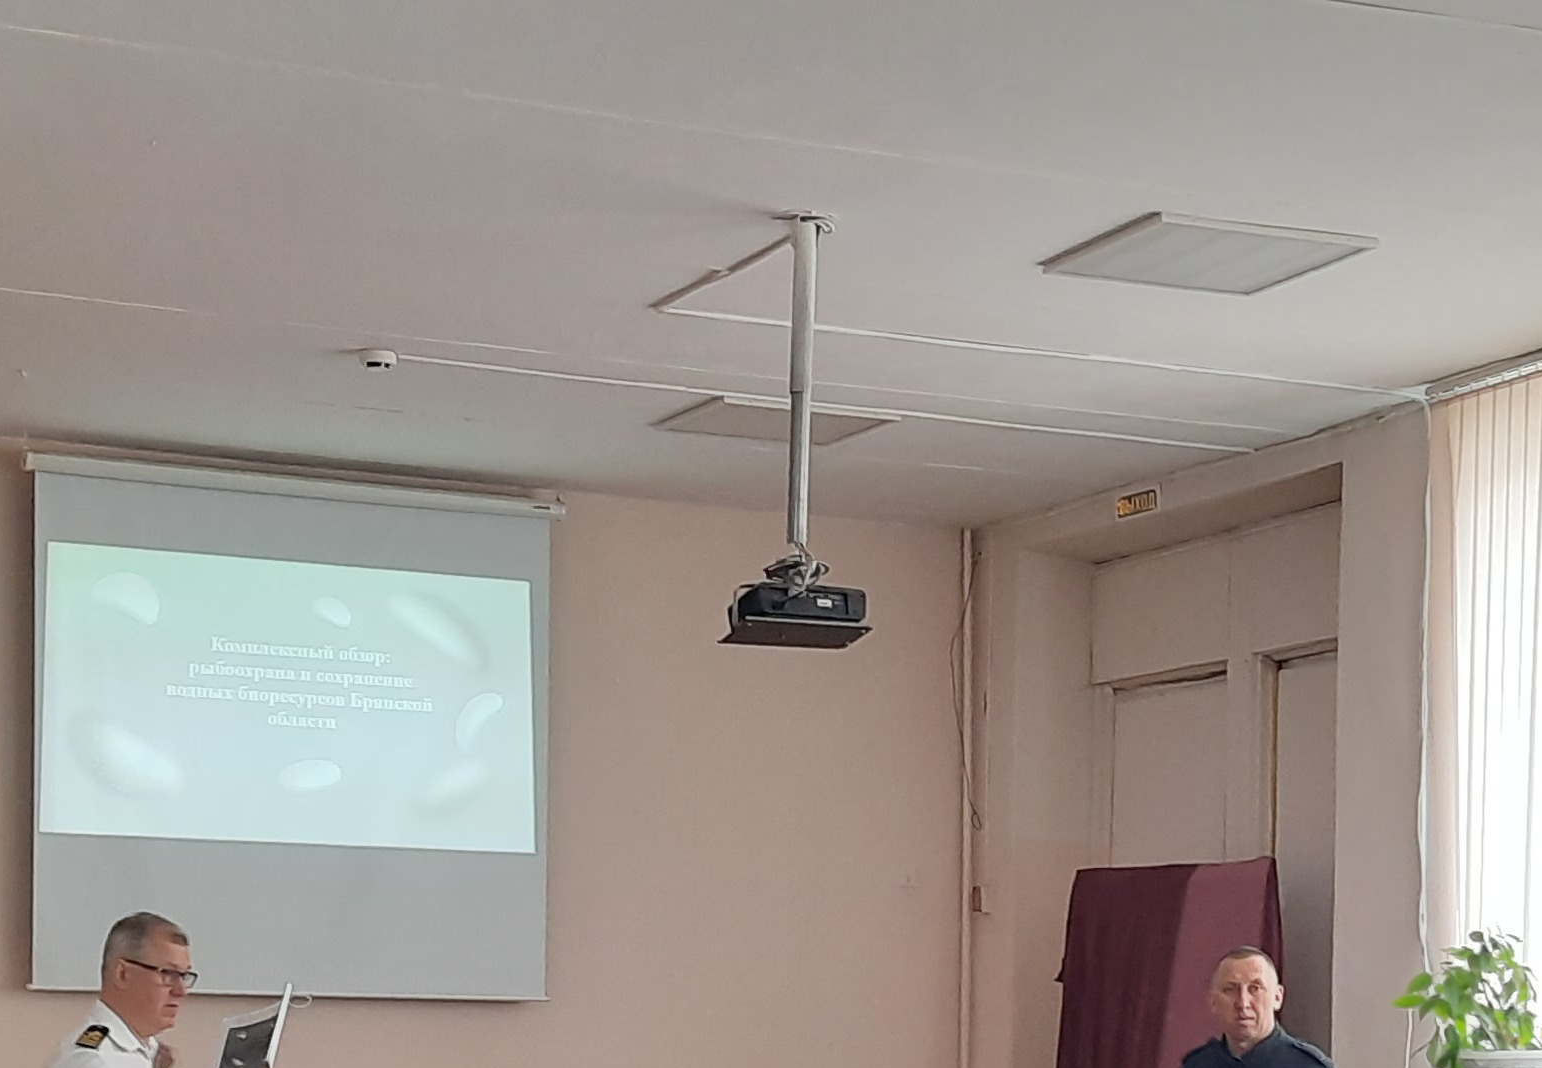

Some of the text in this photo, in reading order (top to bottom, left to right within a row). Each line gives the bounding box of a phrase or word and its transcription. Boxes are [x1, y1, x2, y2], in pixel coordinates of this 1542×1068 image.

[211, 637, 392, 667] Комплексный обзор:
[188, 660, 414, 689] рыбоохрана и сохранение
[166, 684, 434, 713] водных биоресурсов Брянской
[267, 711, 338, 730] области
